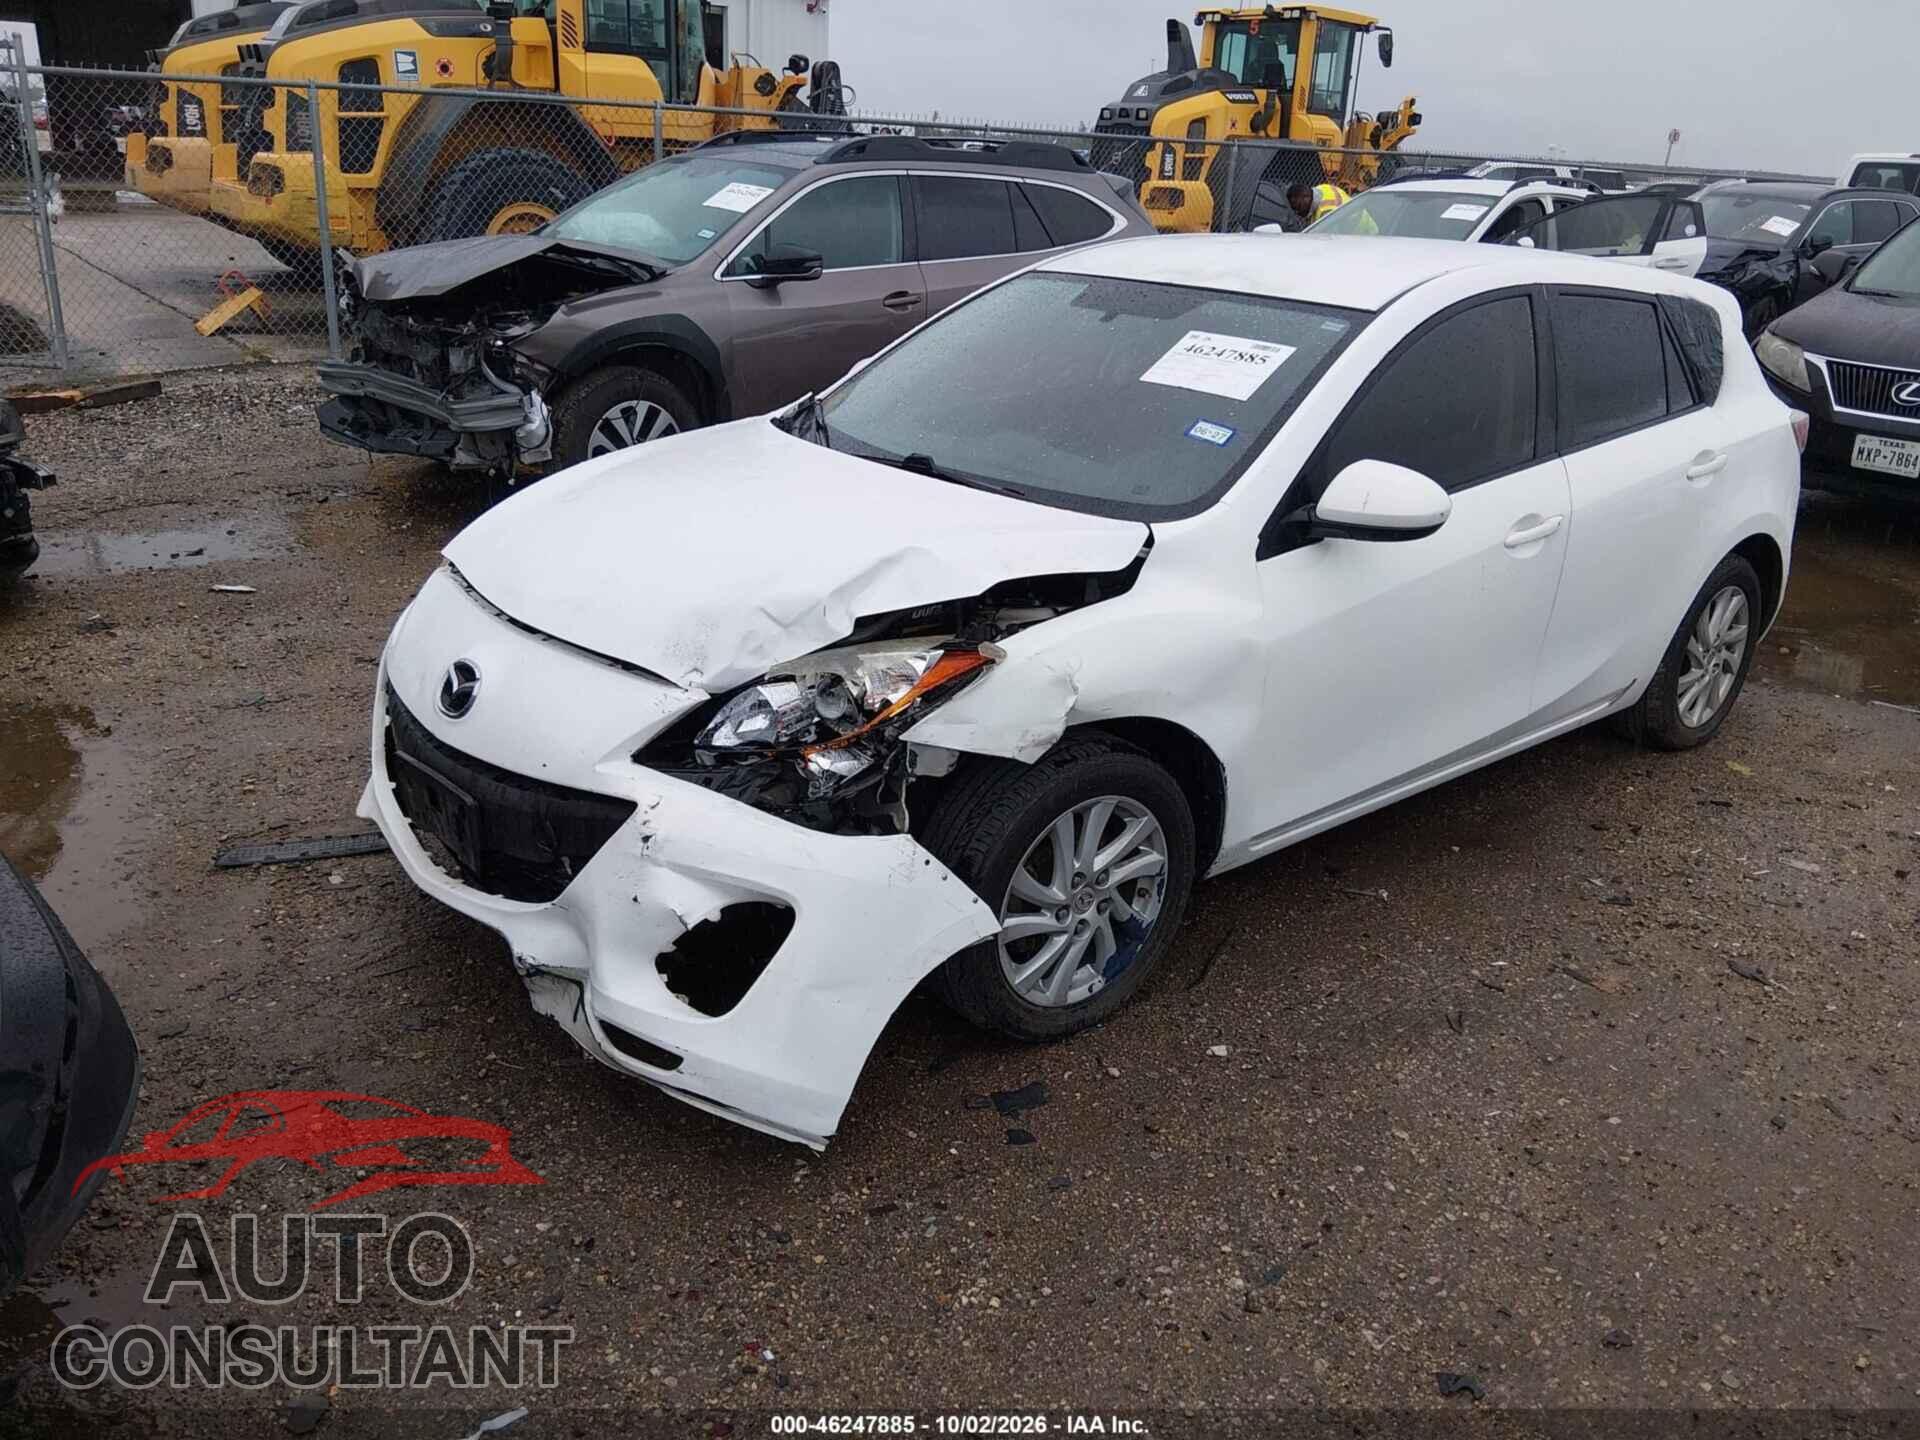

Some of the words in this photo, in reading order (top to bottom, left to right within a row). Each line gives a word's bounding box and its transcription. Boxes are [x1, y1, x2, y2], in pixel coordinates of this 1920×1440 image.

[1249, 18, 1259, 35] 5
[1184, 343, 1271, 365] 46247885
[1880, 439, 1906, 449] TEXAS
